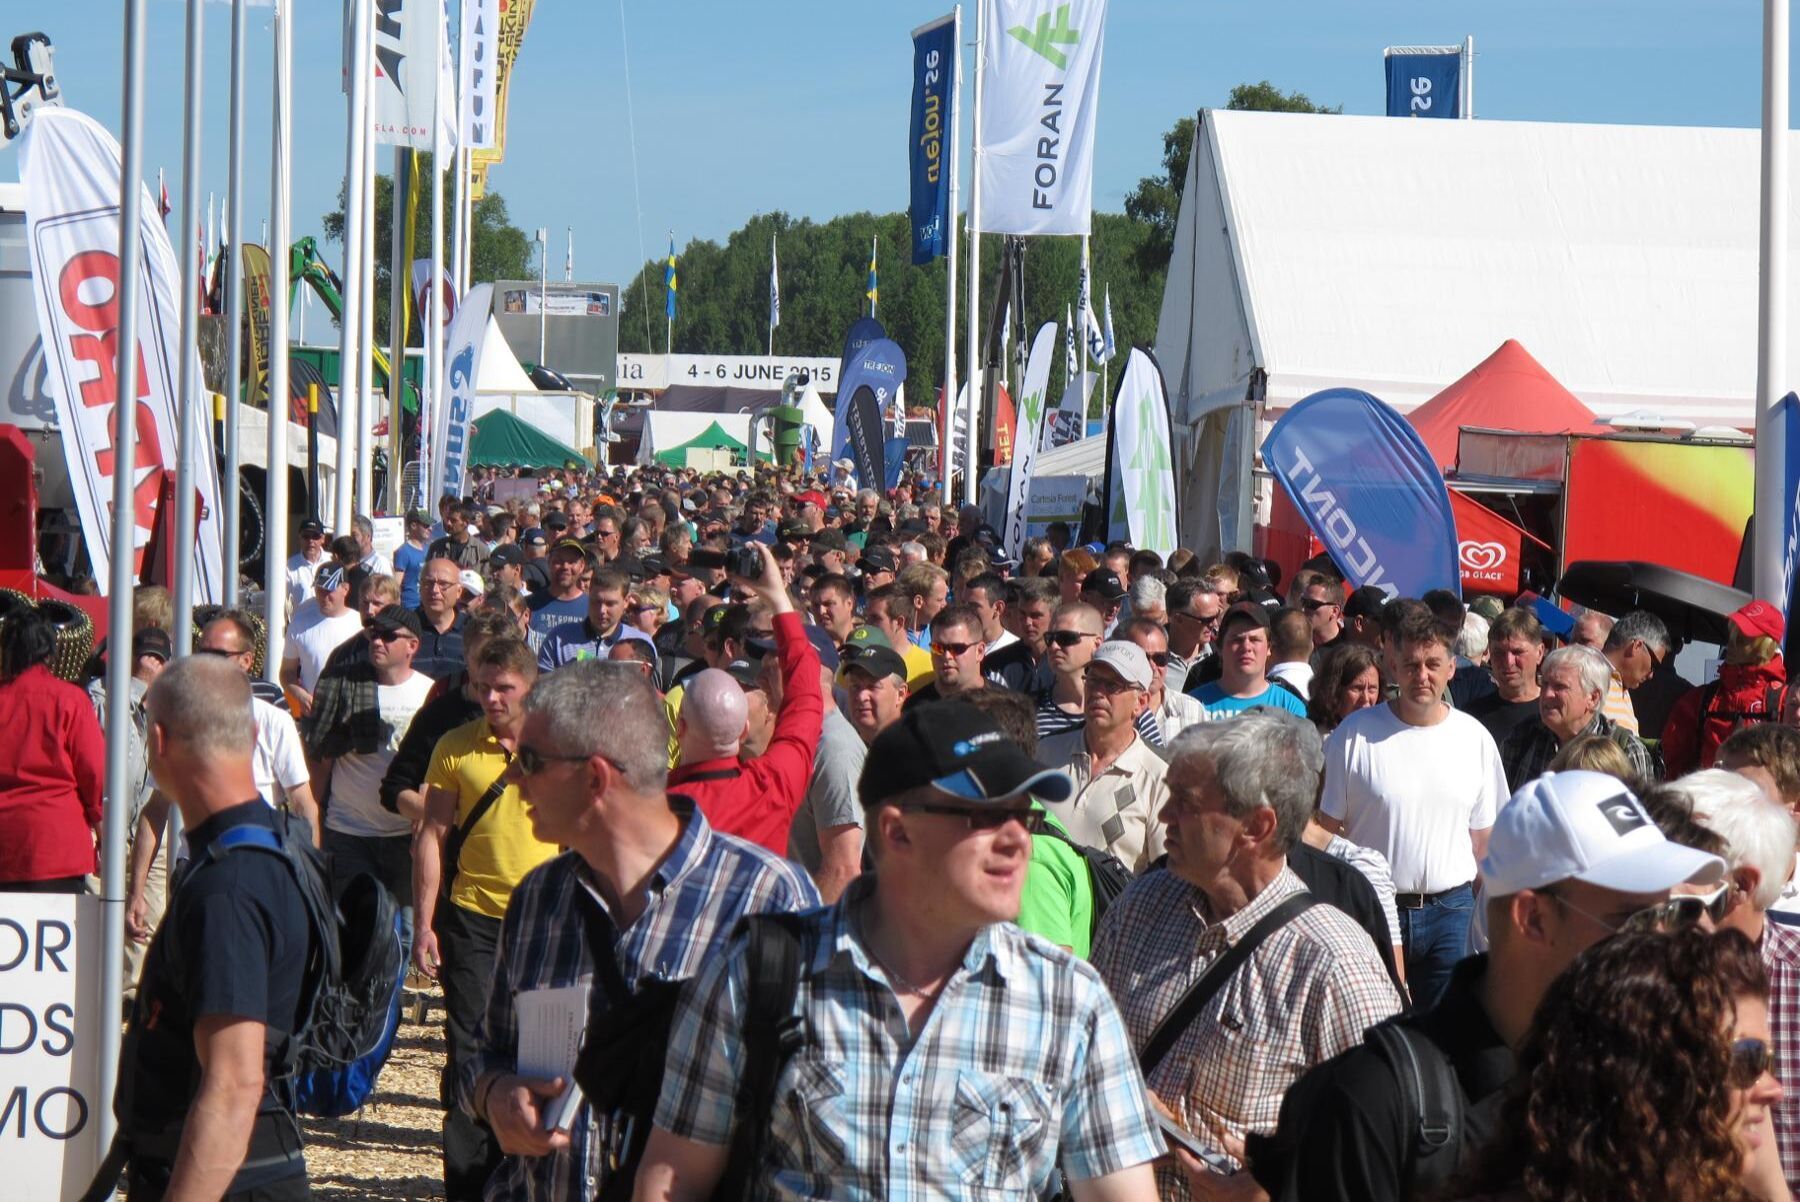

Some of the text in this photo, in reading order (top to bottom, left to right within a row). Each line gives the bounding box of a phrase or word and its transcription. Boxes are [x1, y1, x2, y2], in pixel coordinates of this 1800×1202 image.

[1032, 84, 1065, 210] FORAN
[687, 364, 698, 379] 4
[716, 364, 727, 379] 6
[733, 364, 784, 381] JUNE
[1472, 571, 1502, 581] GLACE
